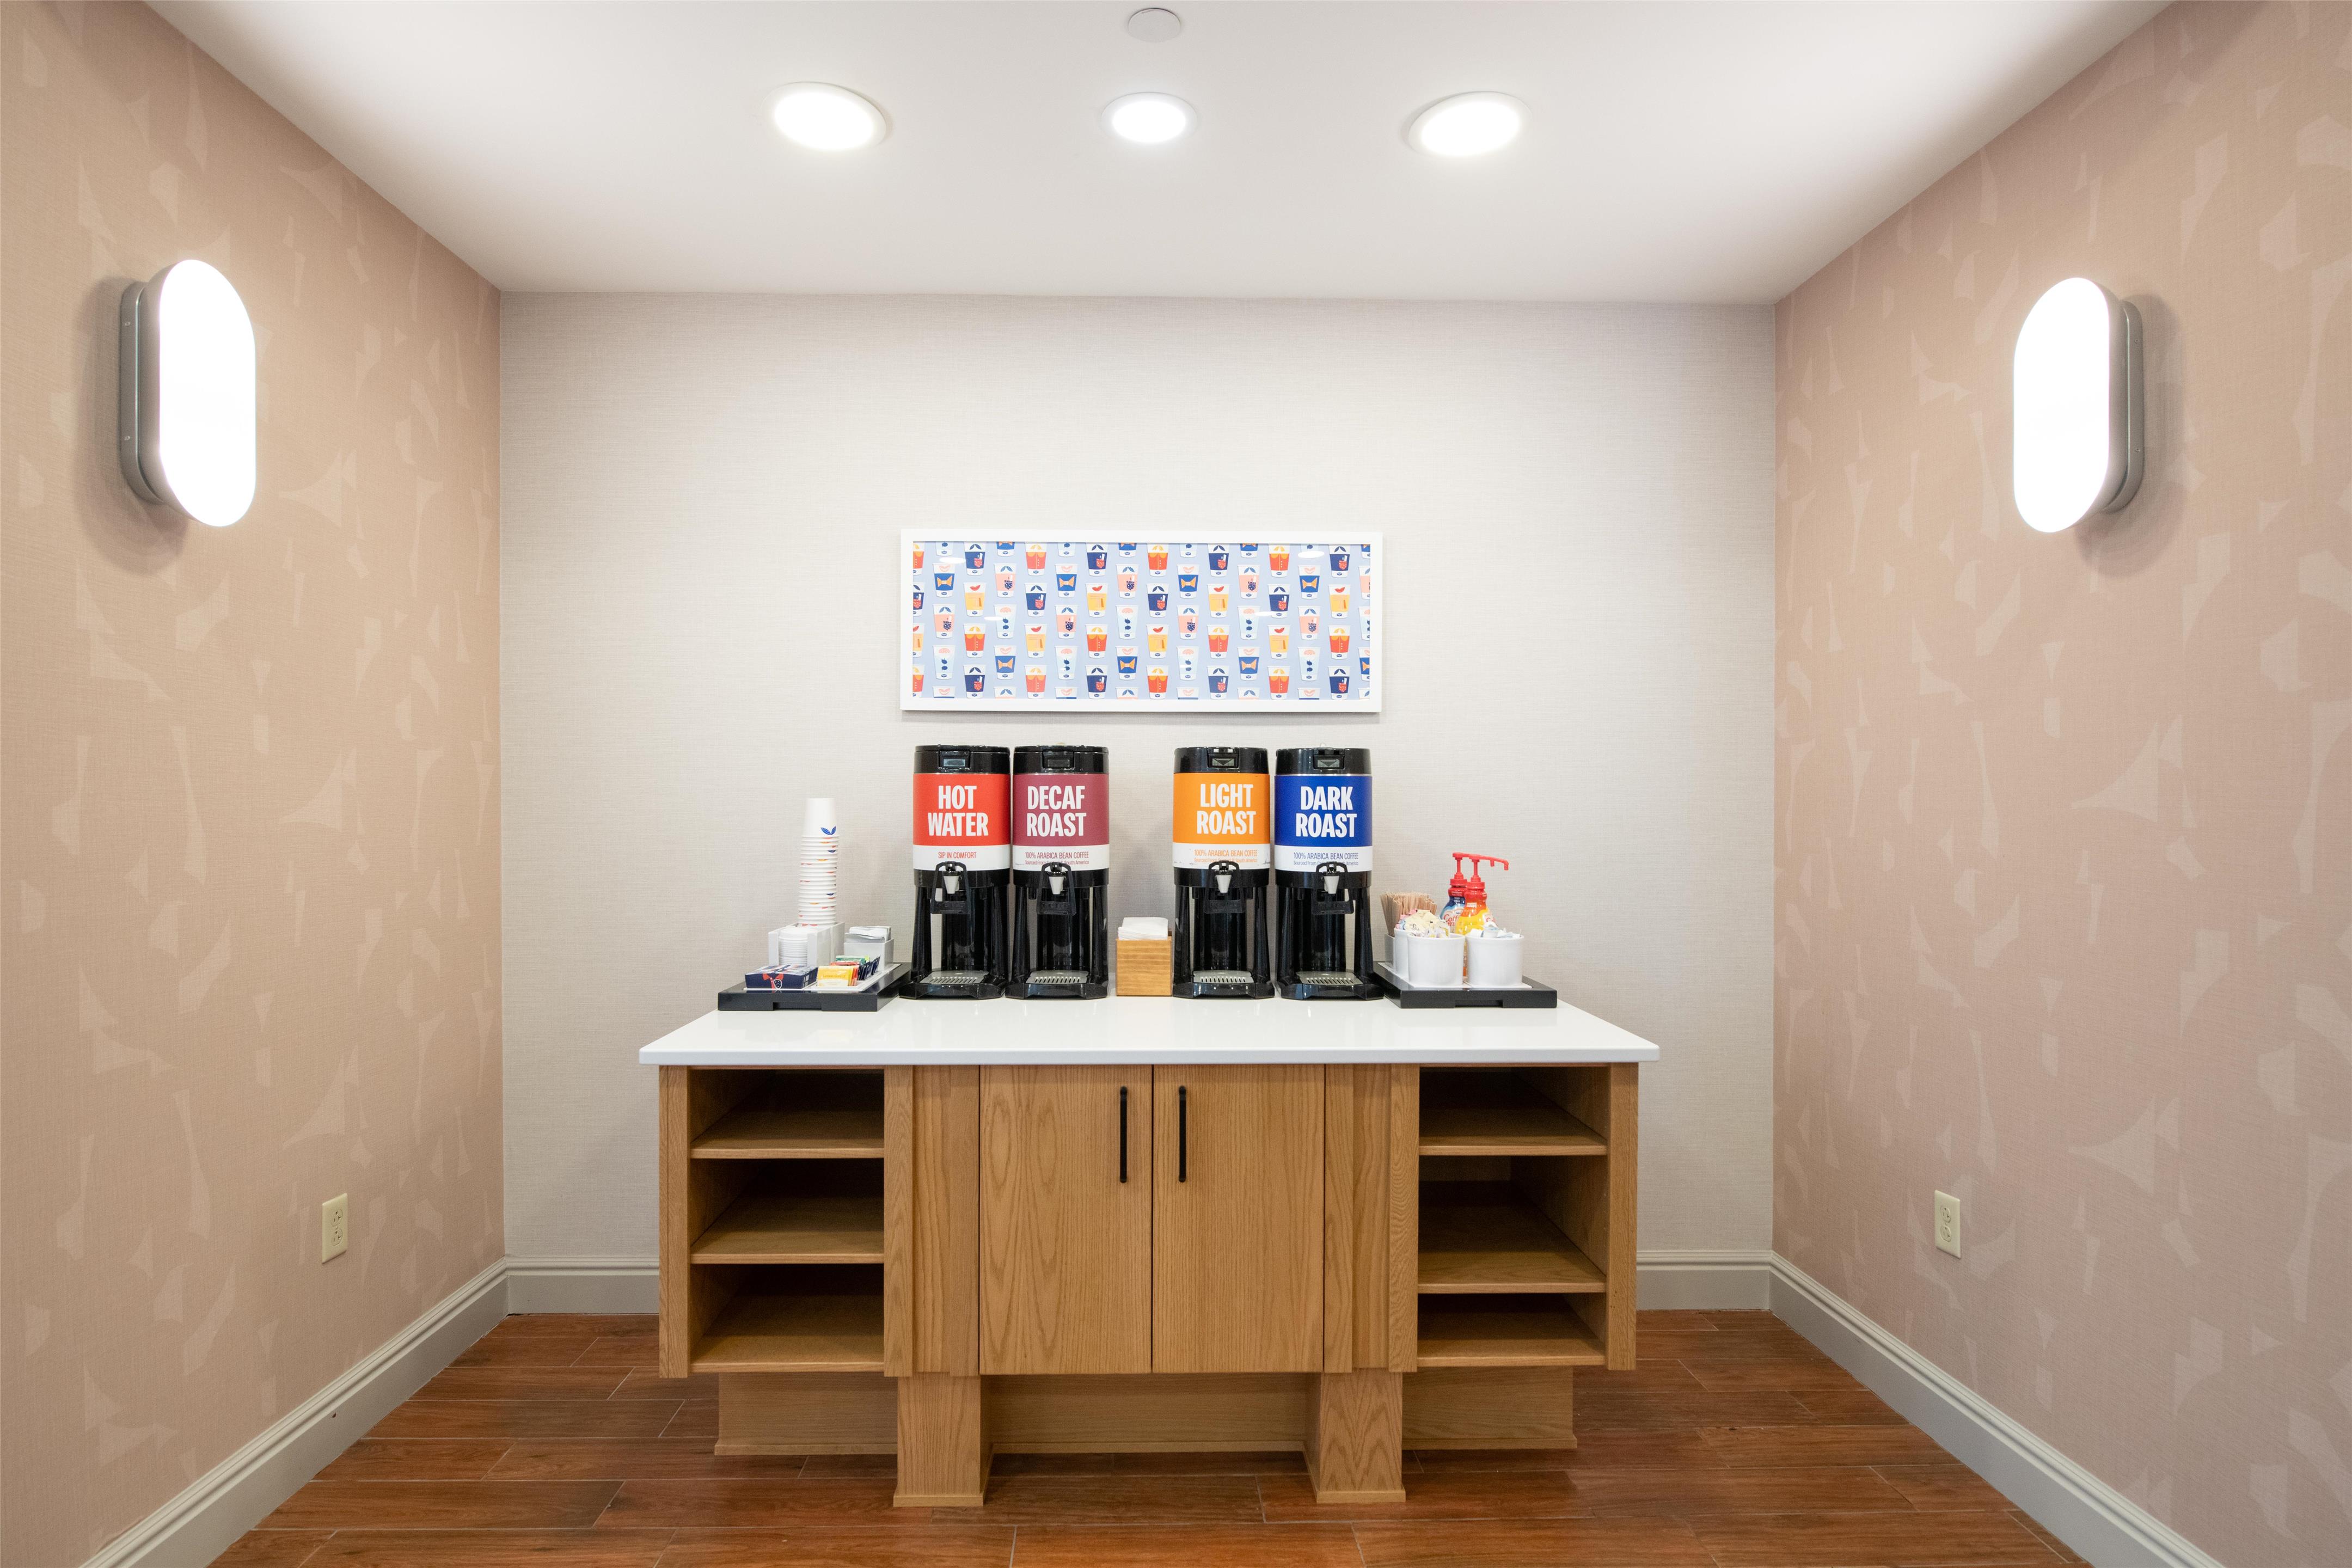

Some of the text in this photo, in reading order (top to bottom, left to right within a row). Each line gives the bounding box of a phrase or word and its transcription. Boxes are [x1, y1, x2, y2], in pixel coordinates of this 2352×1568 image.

[938, 785, 977, 810] HOT
[1027, 786, 1085, 810] DECAF
[1200, 783, 1253, 807] LIGHT
[1301, 786, 1353, 810] DARK
[927, 812, 989, 836] WATER
[1027, 813, 1087, 837] ROAST
[1197, 811, 1256, 835] ROAST
[1296, 813, 1357, 837] ROAST
